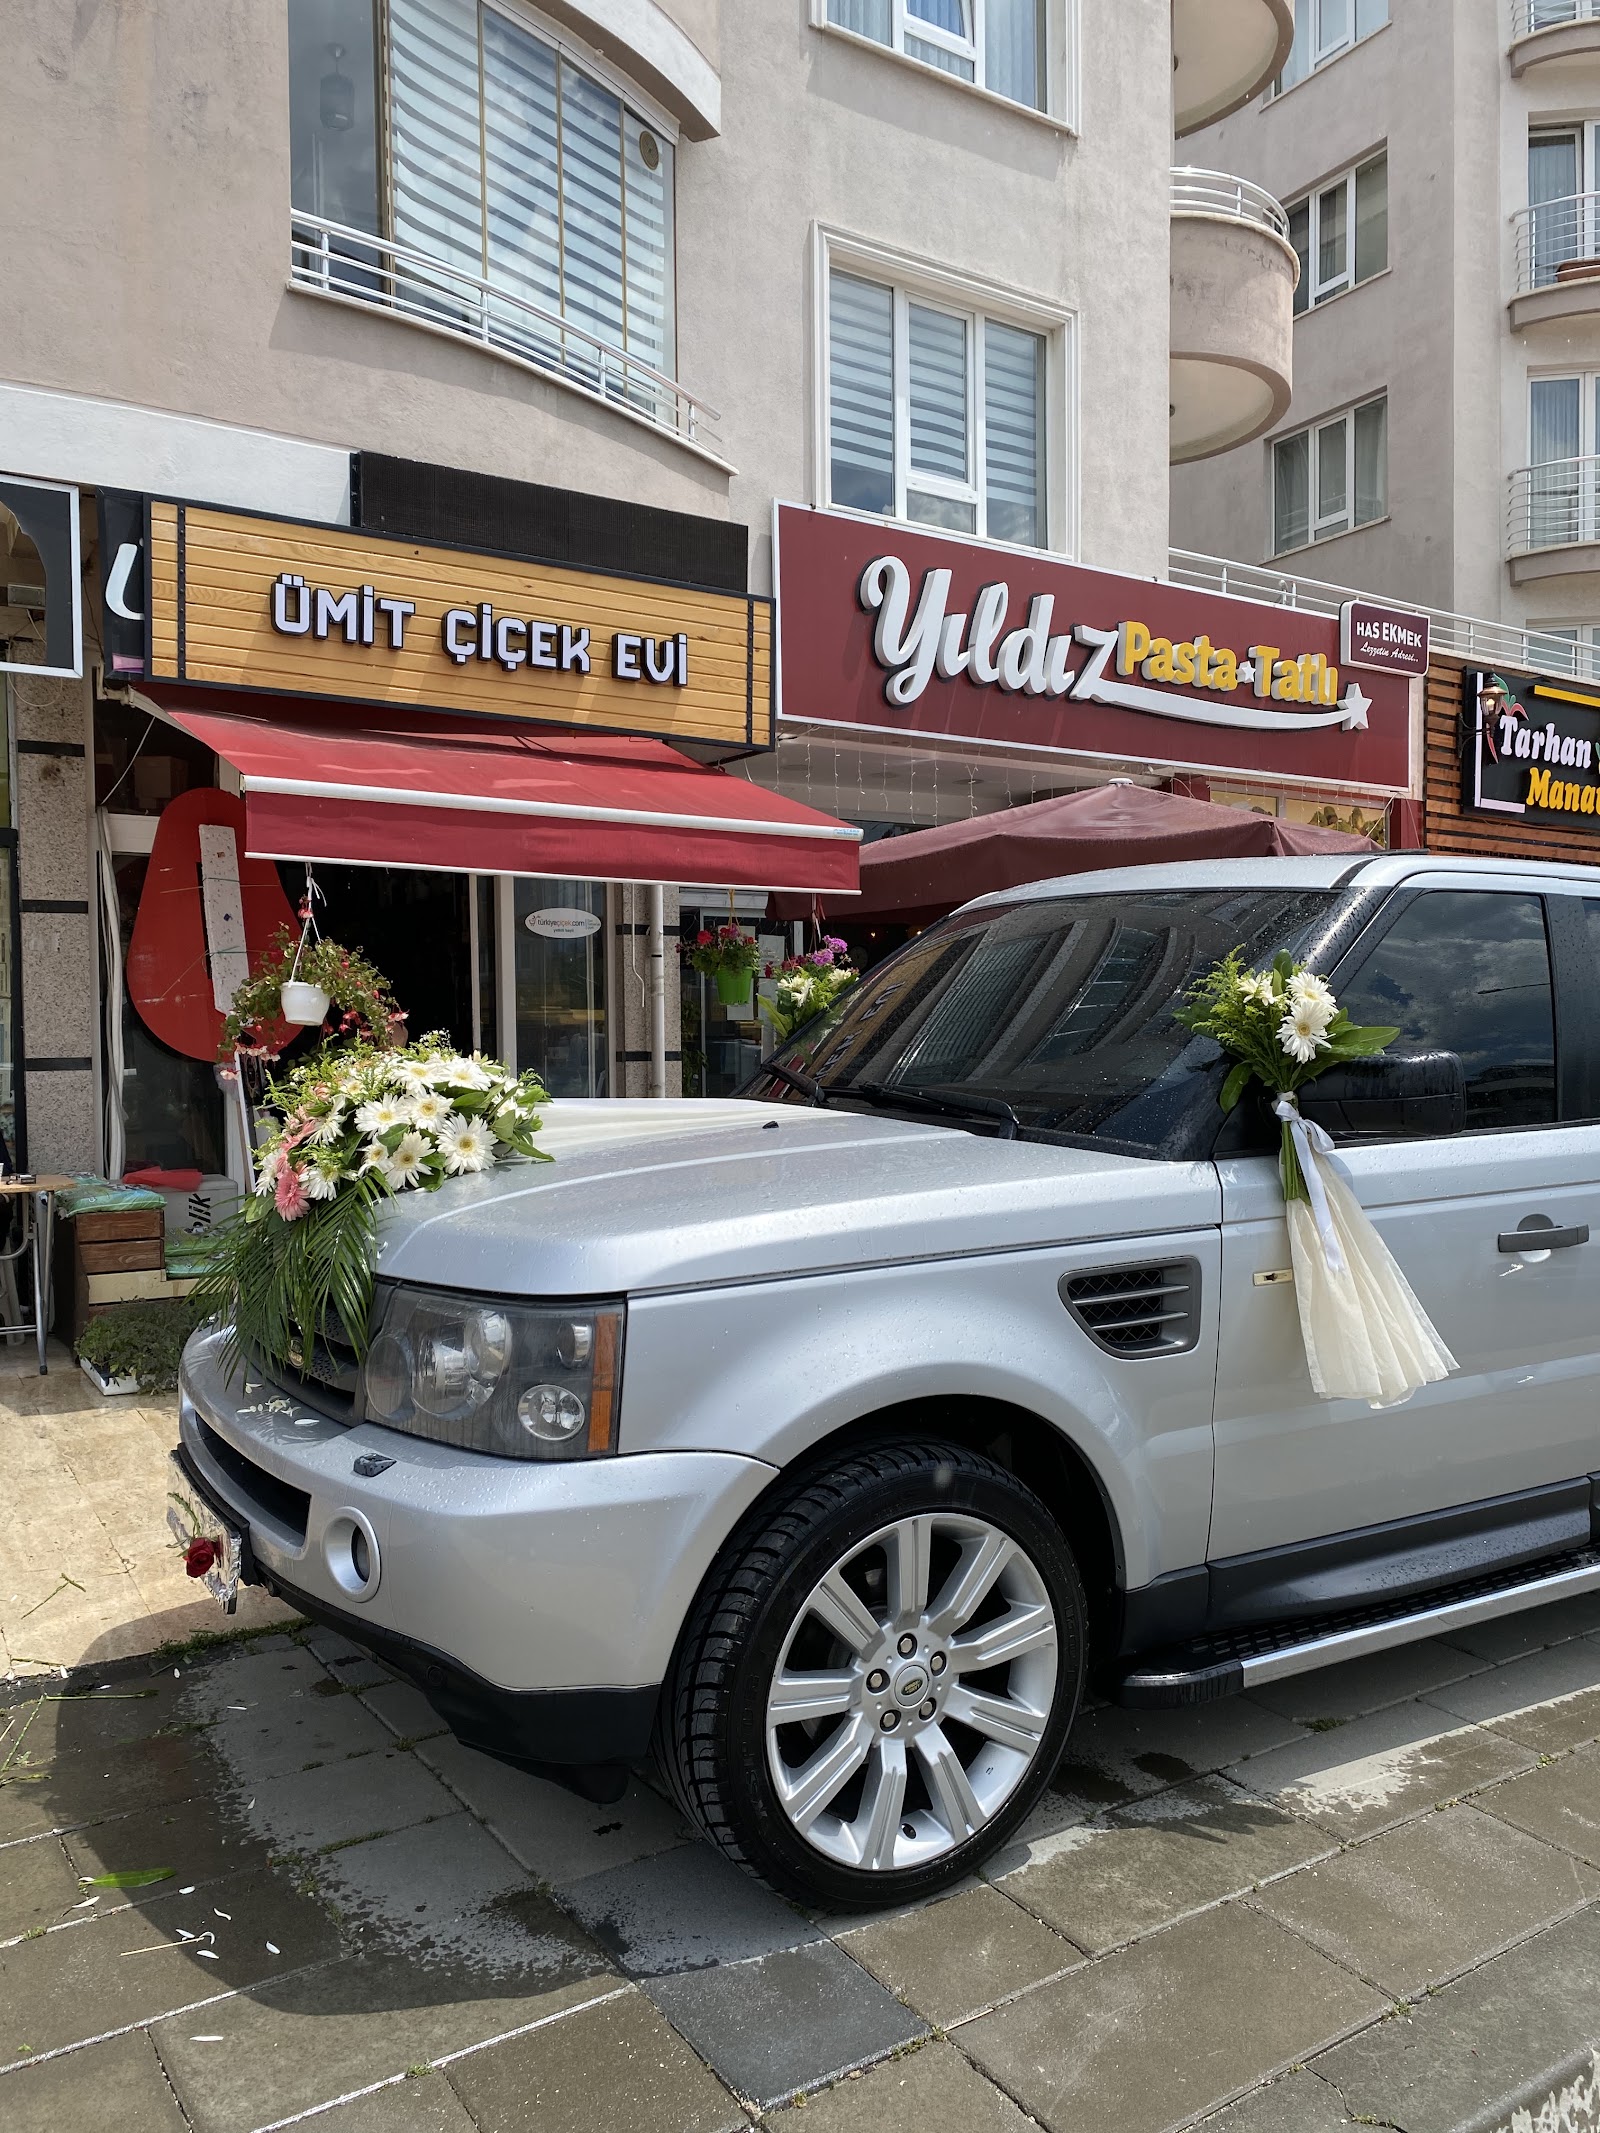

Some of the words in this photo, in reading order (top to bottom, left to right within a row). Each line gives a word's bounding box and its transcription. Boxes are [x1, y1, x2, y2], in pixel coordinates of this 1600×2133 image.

[269, 572, 416, 649] ÜMİT
[441, 602, 592, 671] ÇİÇEK
[611, 632, 690, 687] EVİ
[1356, 621, 1380, 639] HAS
[1382, 621, 1423, 648] EKMEK
[1117, 620, 1238, 692] Pasta
[1248, 644, 1340, 706] Tatlı
[1500, 714, 1592, 769] Tarhan
[1526, 766, 1600, 816] Mana
